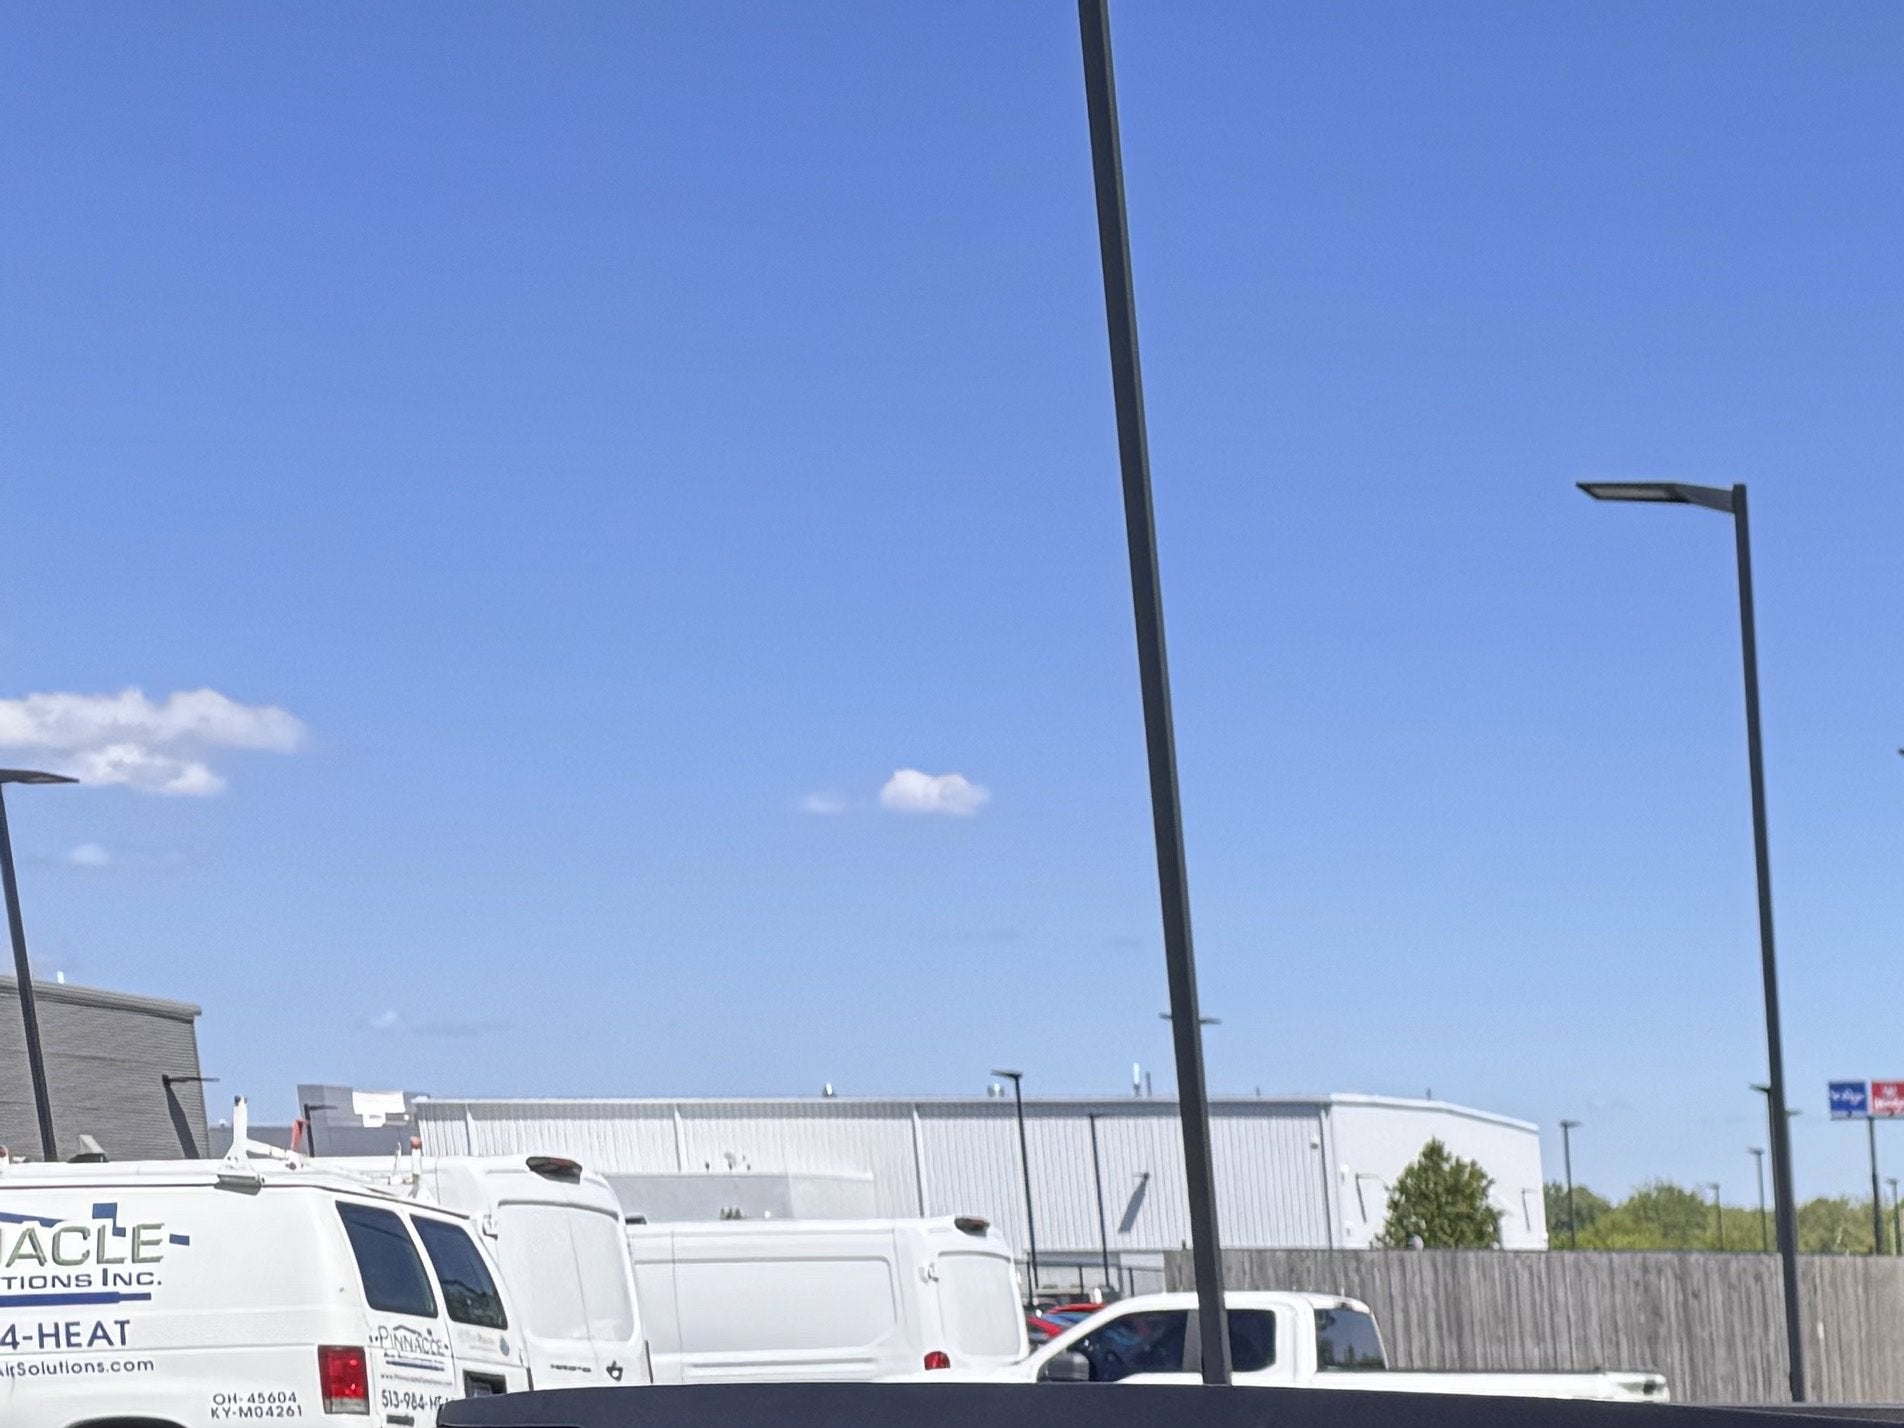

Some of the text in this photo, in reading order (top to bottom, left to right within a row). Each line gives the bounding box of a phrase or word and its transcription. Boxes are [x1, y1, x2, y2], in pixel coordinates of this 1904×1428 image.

[0, 1222, 165, 1268] ACLE
[0, 1319, 131, 1350] 4-HEAT
[377, 1325, 446, 1357] PINNACLE
